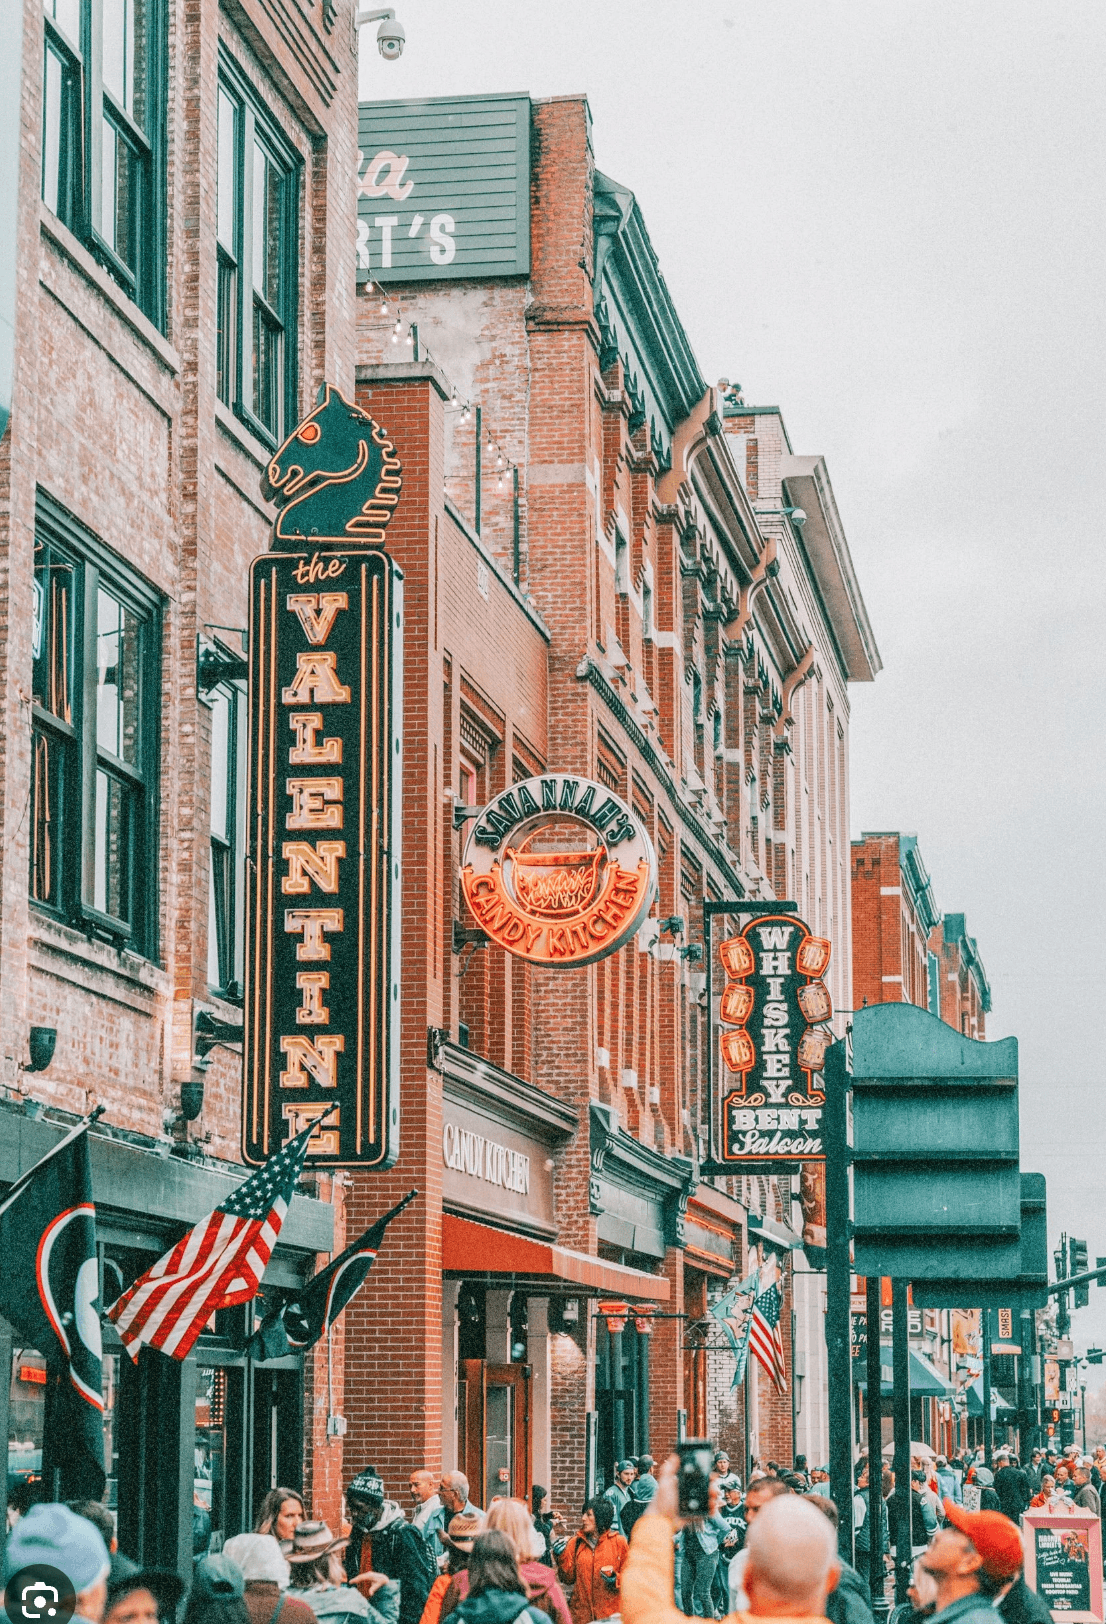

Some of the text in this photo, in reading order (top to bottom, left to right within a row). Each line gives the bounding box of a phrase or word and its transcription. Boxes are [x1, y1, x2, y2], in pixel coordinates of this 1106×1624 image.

[356, 150, 414, 201] a
[292, 552, 346, 584] the
[475, 779, 636, 851] SAVANNAH'S
[280, 592, 351, 1155] VALENTINE
[471, 870, 640, 956] CANDY KITCHEN
[757, 926, 795, 1104] WHISKEY
[731, 1108, 822, 1130] BENT
[731, 1129, 823, 1155] Saloon
[443, 1122, 530, 1195] CANDY KITCHEN
